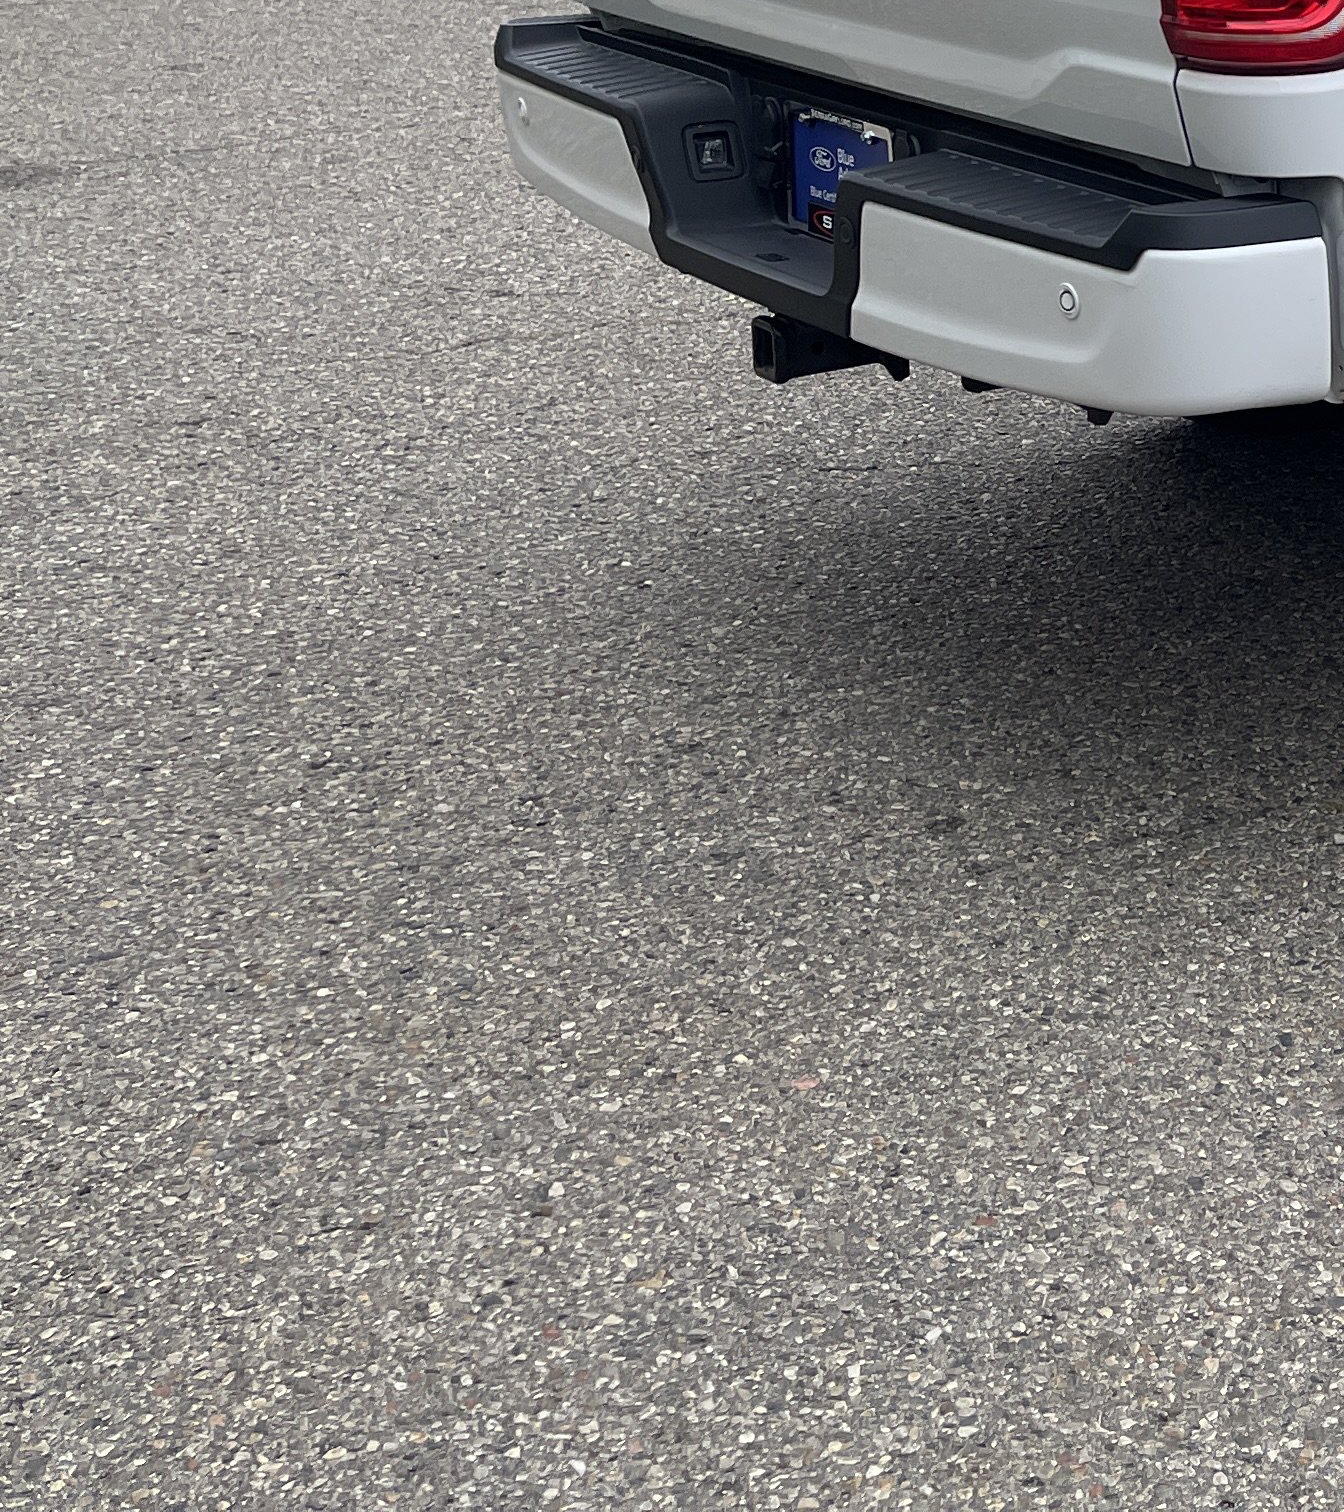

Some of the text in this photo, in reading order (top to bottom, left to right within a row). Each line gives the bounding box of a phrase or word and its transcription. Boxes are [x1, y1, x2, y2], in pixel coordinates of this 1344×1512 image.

[814, 148, 832, 169] Ford
[836, 148, 855, 167] Blue
[810, 185, 822, 200] Blue
